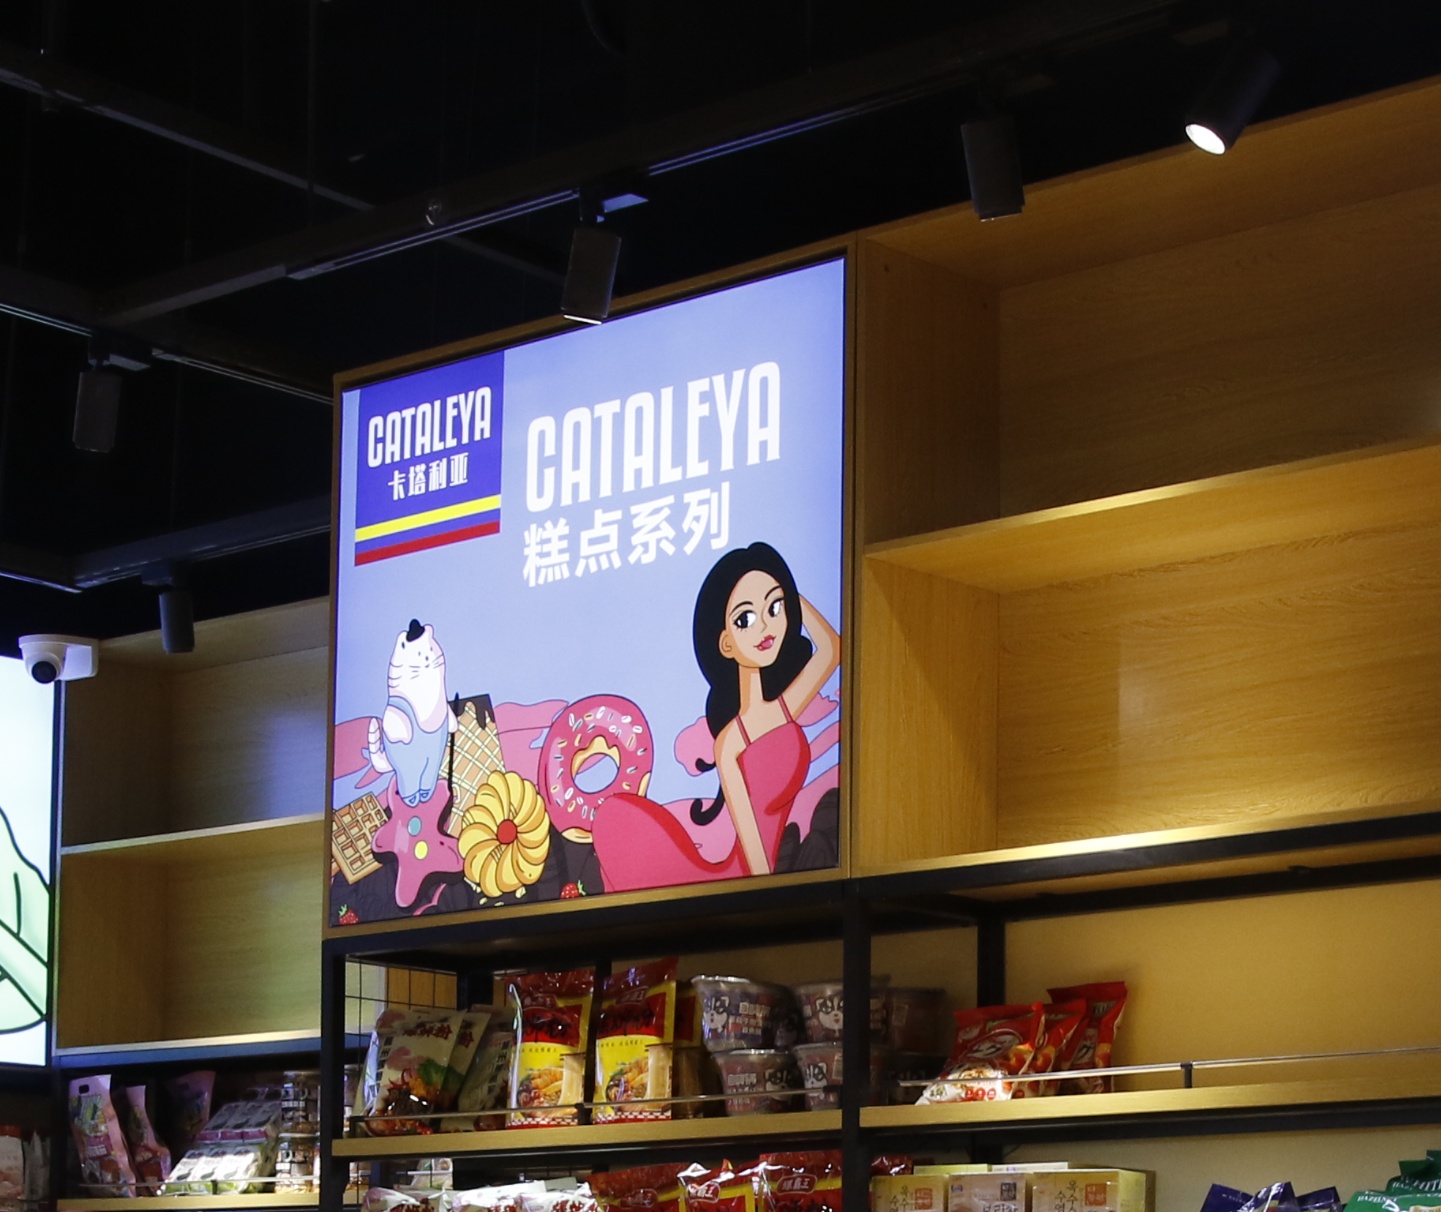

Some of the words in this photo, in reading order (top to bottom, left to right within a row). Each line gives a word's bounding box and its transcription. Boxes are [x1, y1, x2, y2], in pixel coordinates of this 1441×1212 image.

[368, 387, 492, 468] CATALEYA
[526, 361, 779, 512] CATALEYA
[388, 453, 469, 500] 卡塔利亚
[522, 482, 730, 586] 糕点系列
